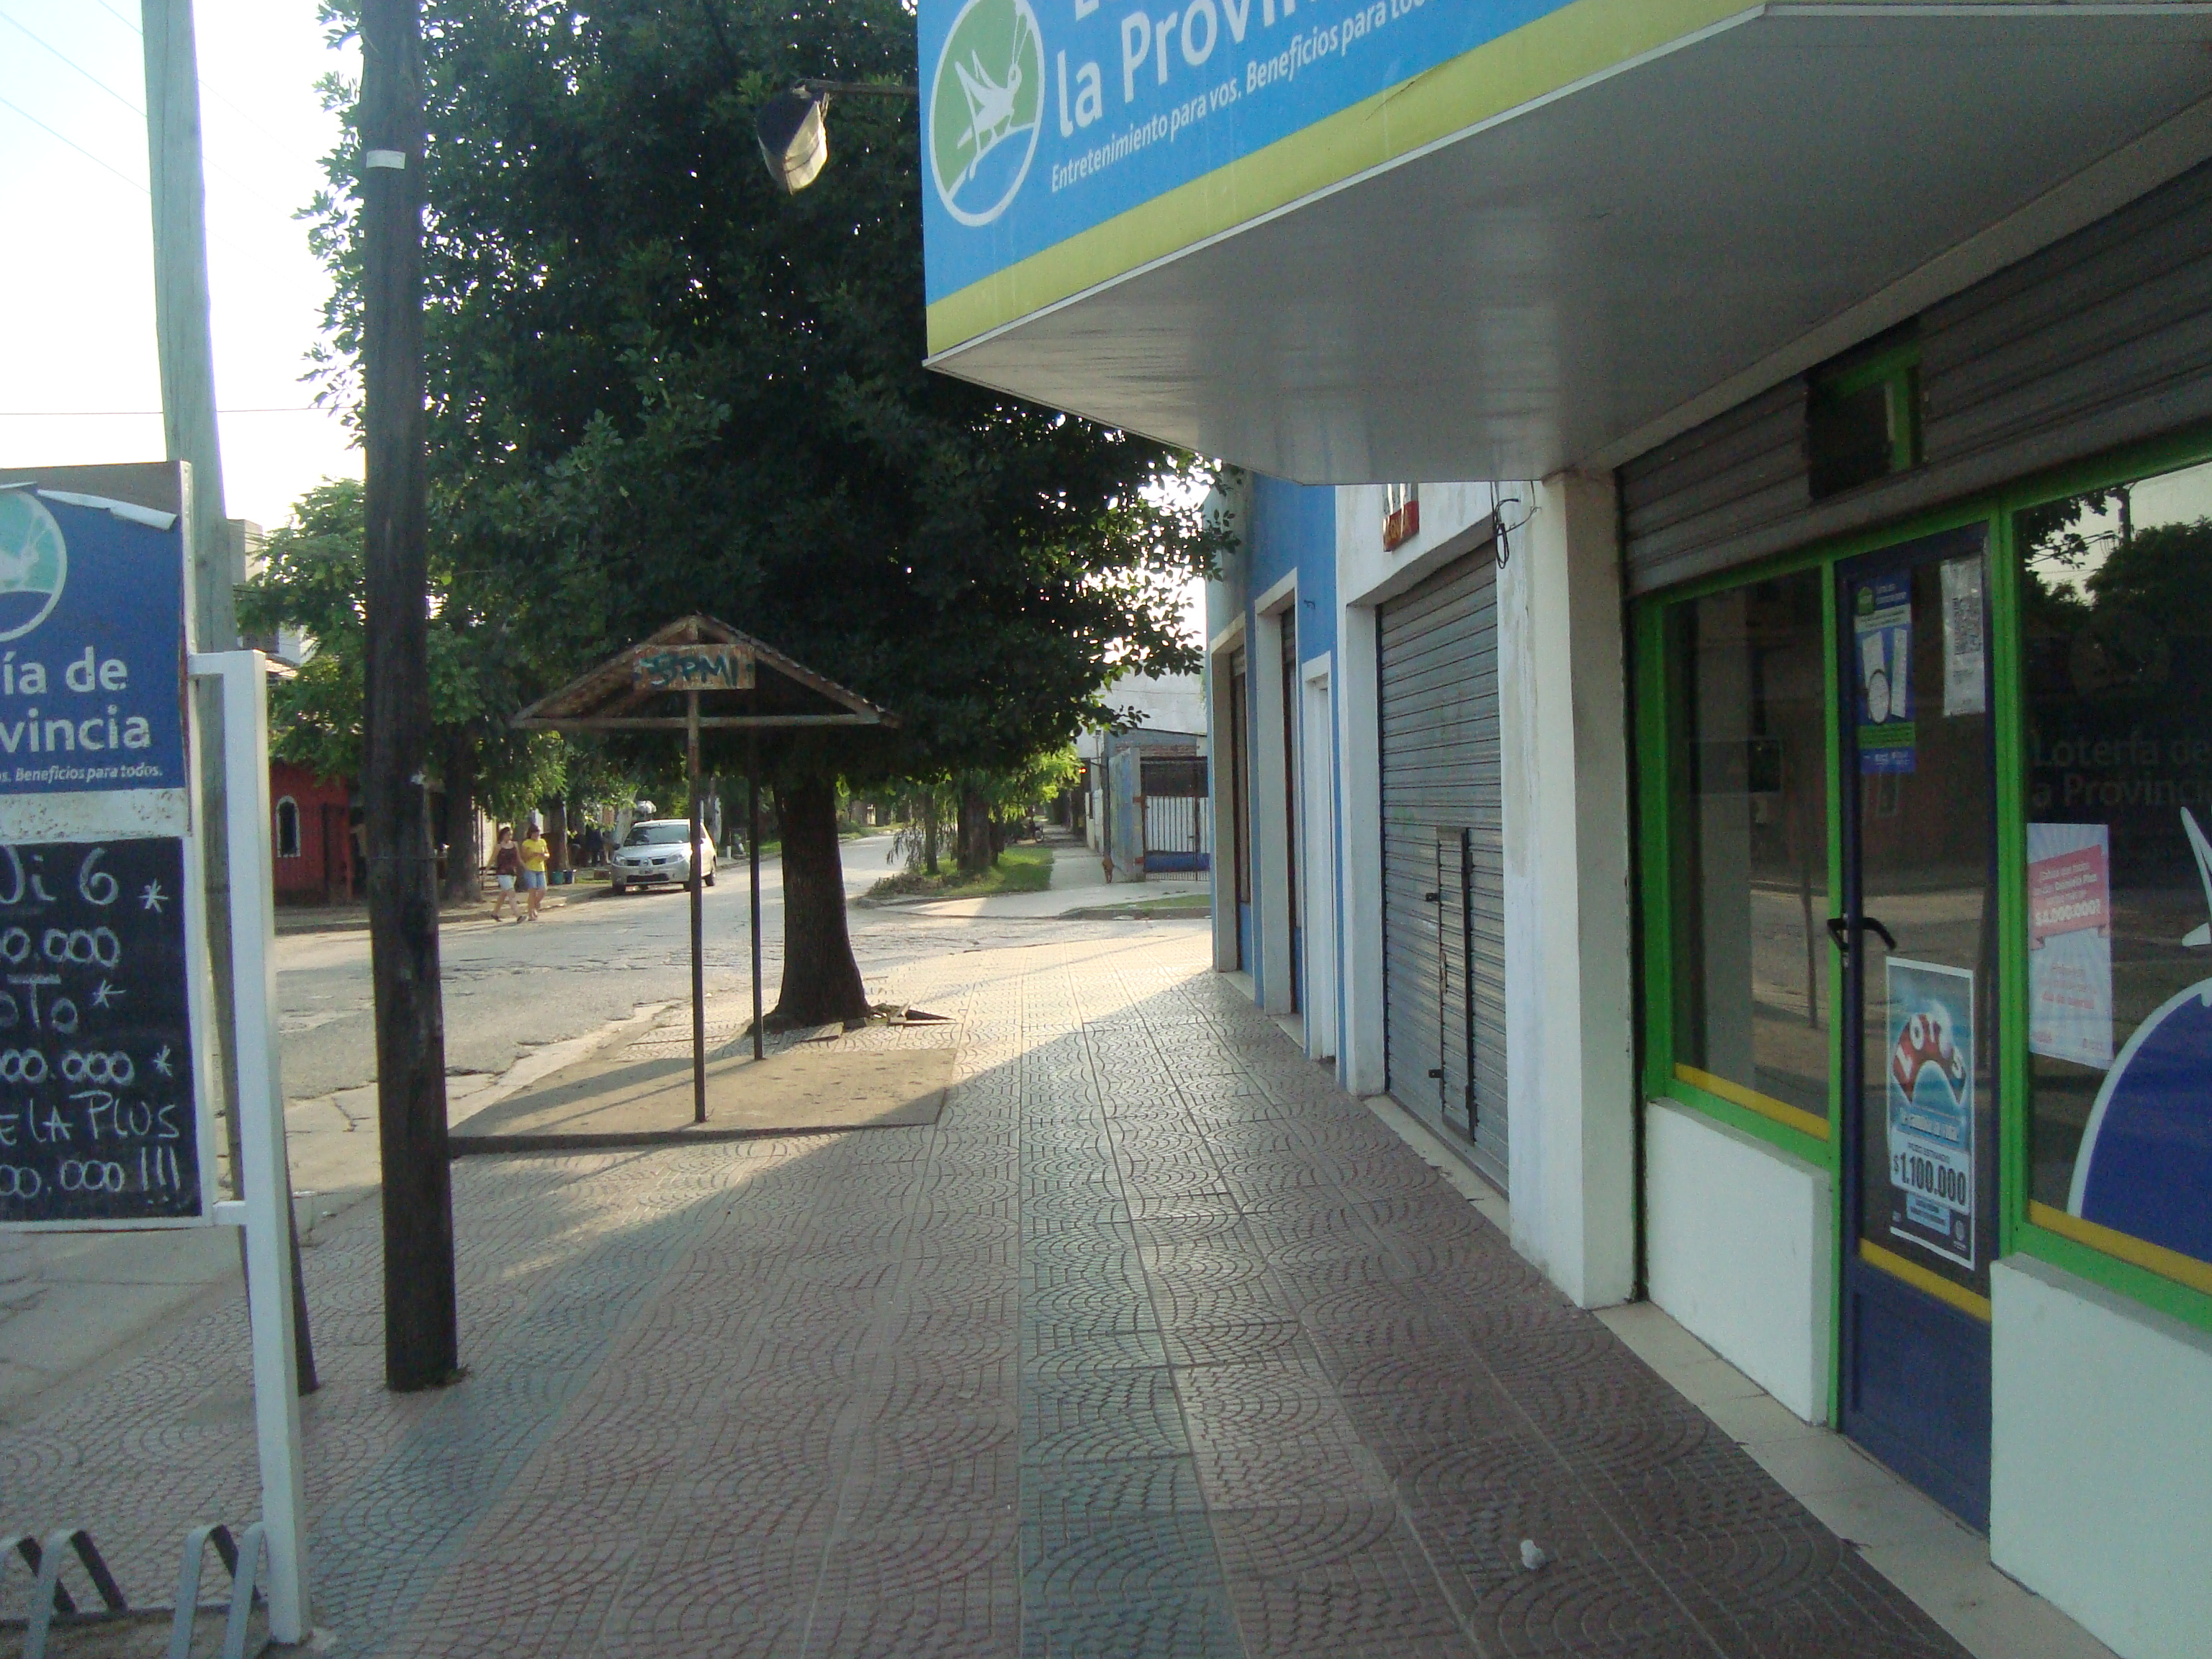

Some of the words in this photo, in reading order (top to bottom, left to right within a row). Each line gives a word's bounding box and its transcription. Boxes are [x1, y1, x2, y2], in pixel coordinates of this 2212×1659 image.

[1051, 113, 1168, 193] Entretenimiento
[1171, 94, 1207, 142] para
[1210, 77, 1242, 112] vos.
[1246, 25, 1338, 94] Beneficios
[1341, 1, 1387, 57] para
[1057, 49, 1102, 138] la
[66, 646, 128, 693] de
[0, 703, 152, 753] vincia
[15, 765, 85, 784] Beneficios
[86, 767, 118, 783] para
[120, 762, 163, 778] todos.
[79, 847, 120, 906] 6
